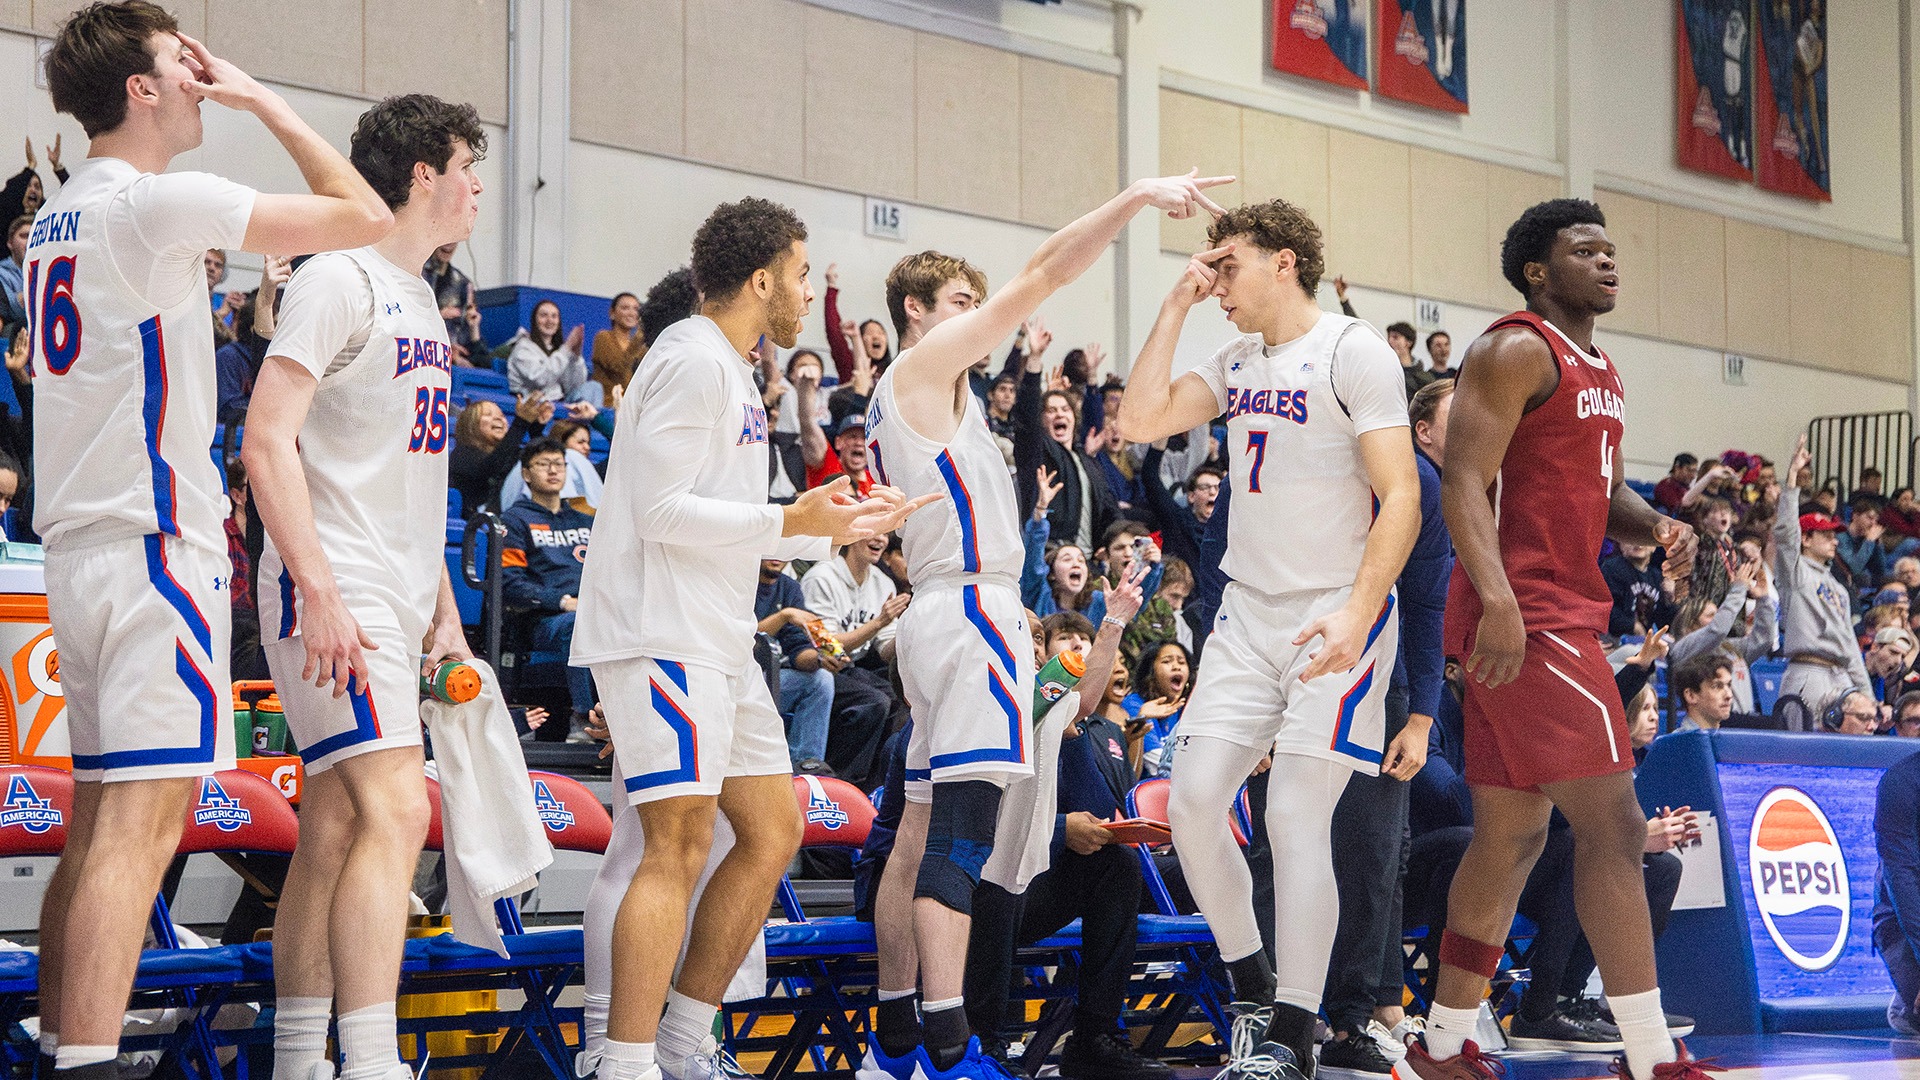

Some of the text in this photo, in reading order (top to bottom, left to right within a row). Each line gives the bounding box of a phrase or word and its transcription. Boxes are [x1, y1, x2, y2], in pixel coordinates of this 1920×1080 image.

[29, 211, 81, 248] BROWN
[873, 204, 900, 228] 115
[28, 254, 83, 377] 16
[1420, 302, 1440, 323] 116
[392, 337, 452, 380] EAGLE
[407, 386, 448, 454] 35
[1227, 387, 1309, 425] EAGLES
[1577, 387, 1625, 428] COLGAT
[1245, 430, 1269, 494] 7
[1601, 429, 1614, 499] 4
[530, 527, 591, 548] BEARS
[271, 764, 297, 799] G
[3, 811, 59, 823] AMERICAN
[198, 810, 248, 821] AMERICAN
[1759, 861, 1841, 895] PEPSI
